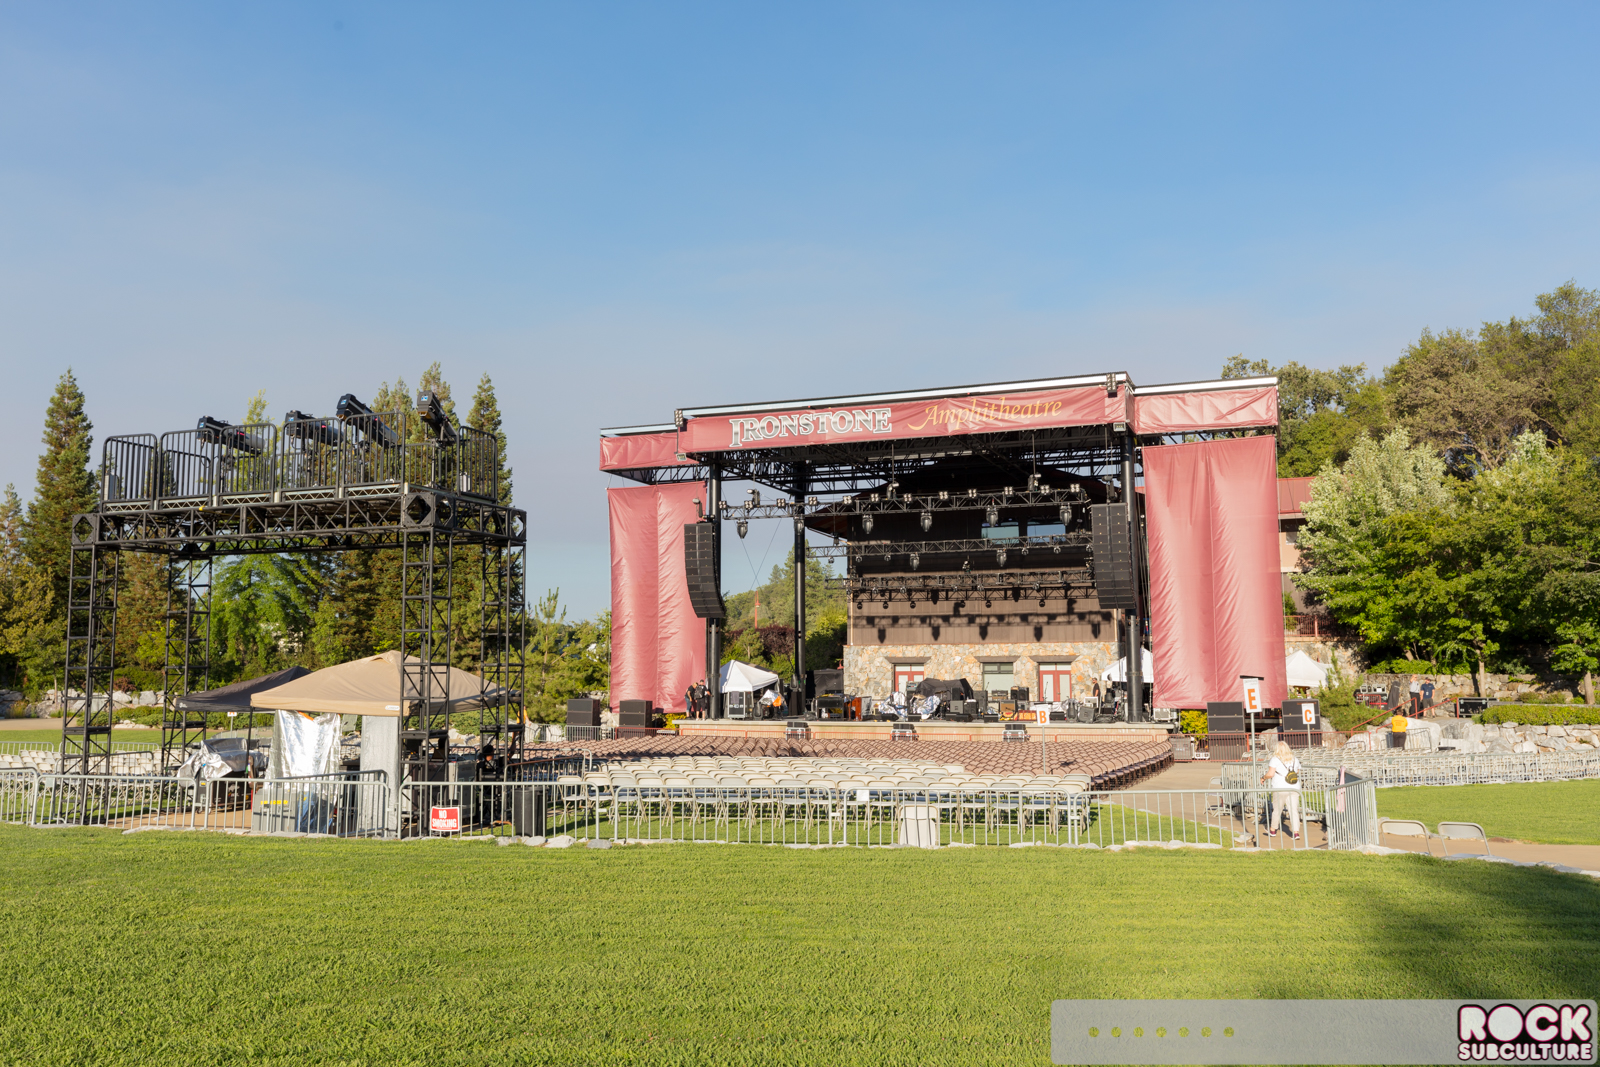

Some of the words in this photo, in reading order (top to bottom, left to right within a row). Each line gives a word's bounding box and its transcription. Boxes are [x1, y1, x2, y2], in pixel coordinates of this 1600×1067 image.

[729, 408, 892, 447] IRONSTONE
[907, 397, 1062, 431] Amphitheatre
[1247, 688, 1257, 709] E
[1039, 710, 1047, 724] B
[1304, 709, 1312, 723] C
[438, 809, 447, 819] NO
[432, 818, 457, 828] SMOKING
